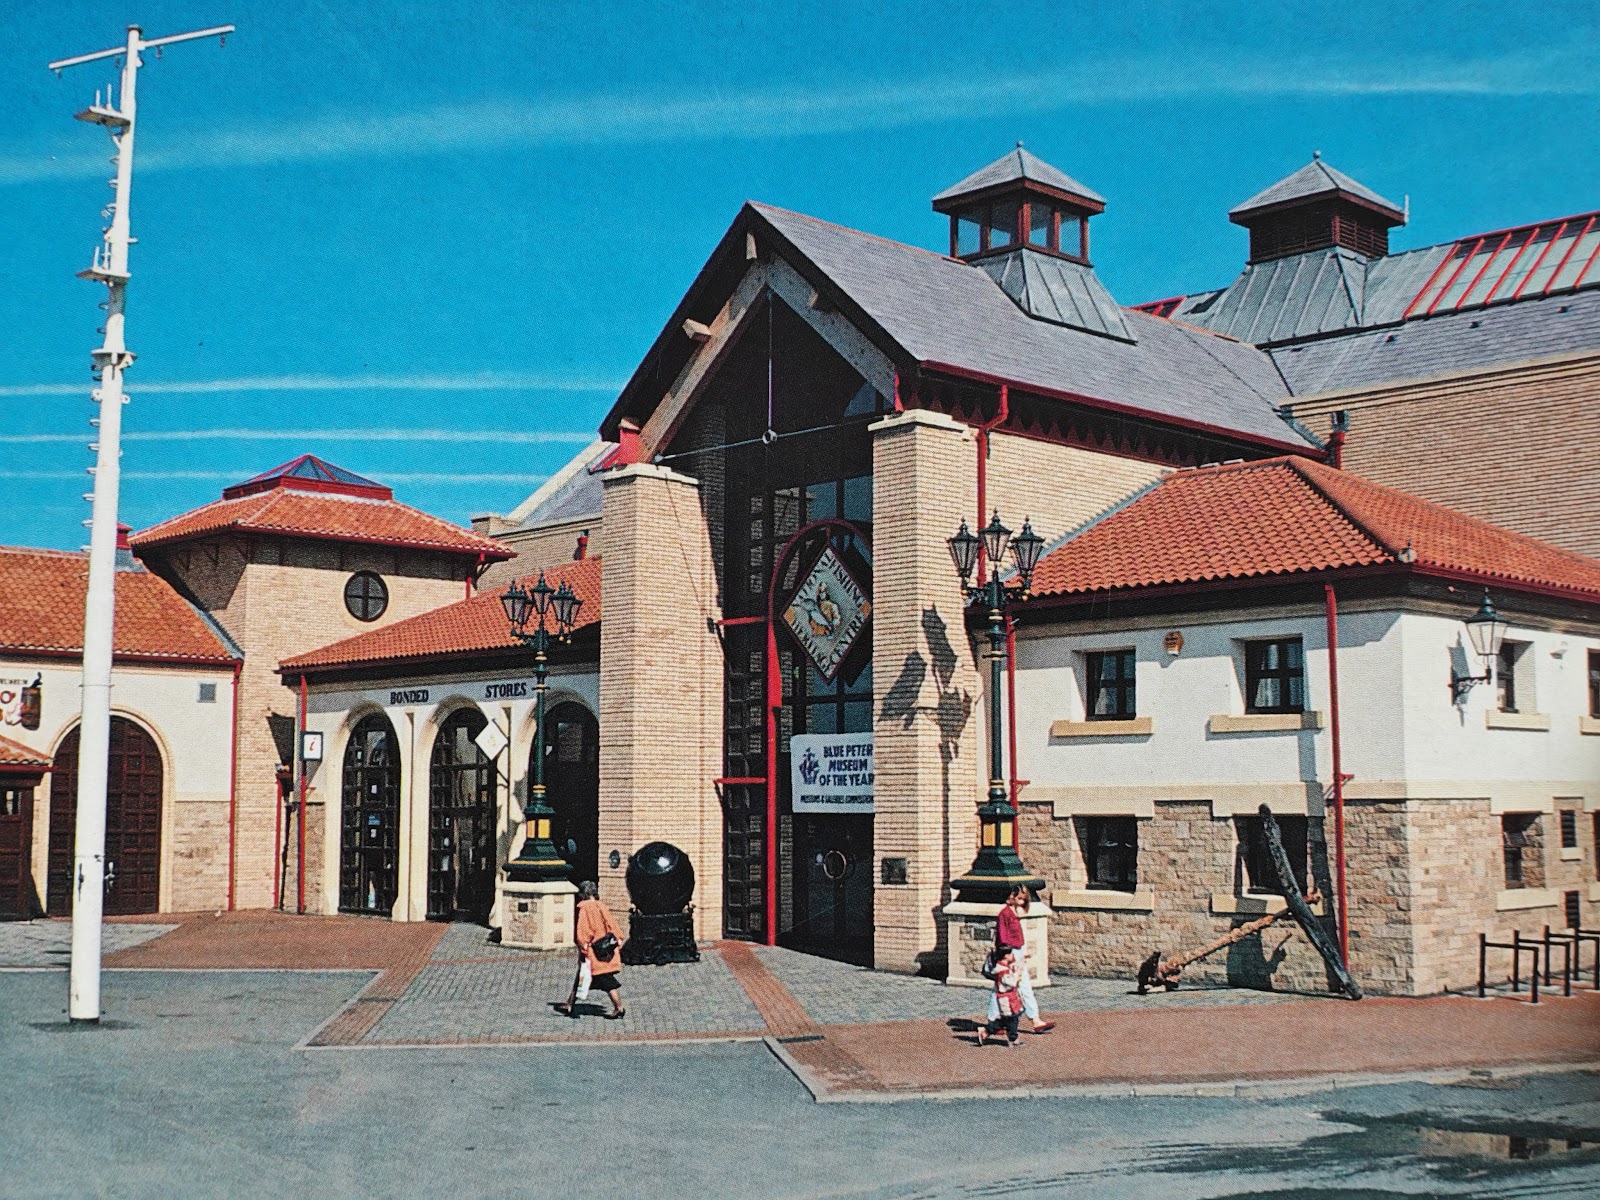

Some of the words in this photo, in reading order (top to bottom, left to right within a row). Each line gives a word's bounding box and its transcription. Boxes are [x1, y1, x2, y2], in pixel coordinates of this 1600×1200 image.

[390, 690, 429, 704] BONDED
[485, 682, 527, 698] STORES
[823, 745, 844, 758] BLUE
[845, 743, 873, 757] PETER
[828, 758, 868, 772] MUSEUM
[819, 774, 831, 786] OF
[832, 774, 848, 786] THE
[848, 773, 874, 786] YEAR
